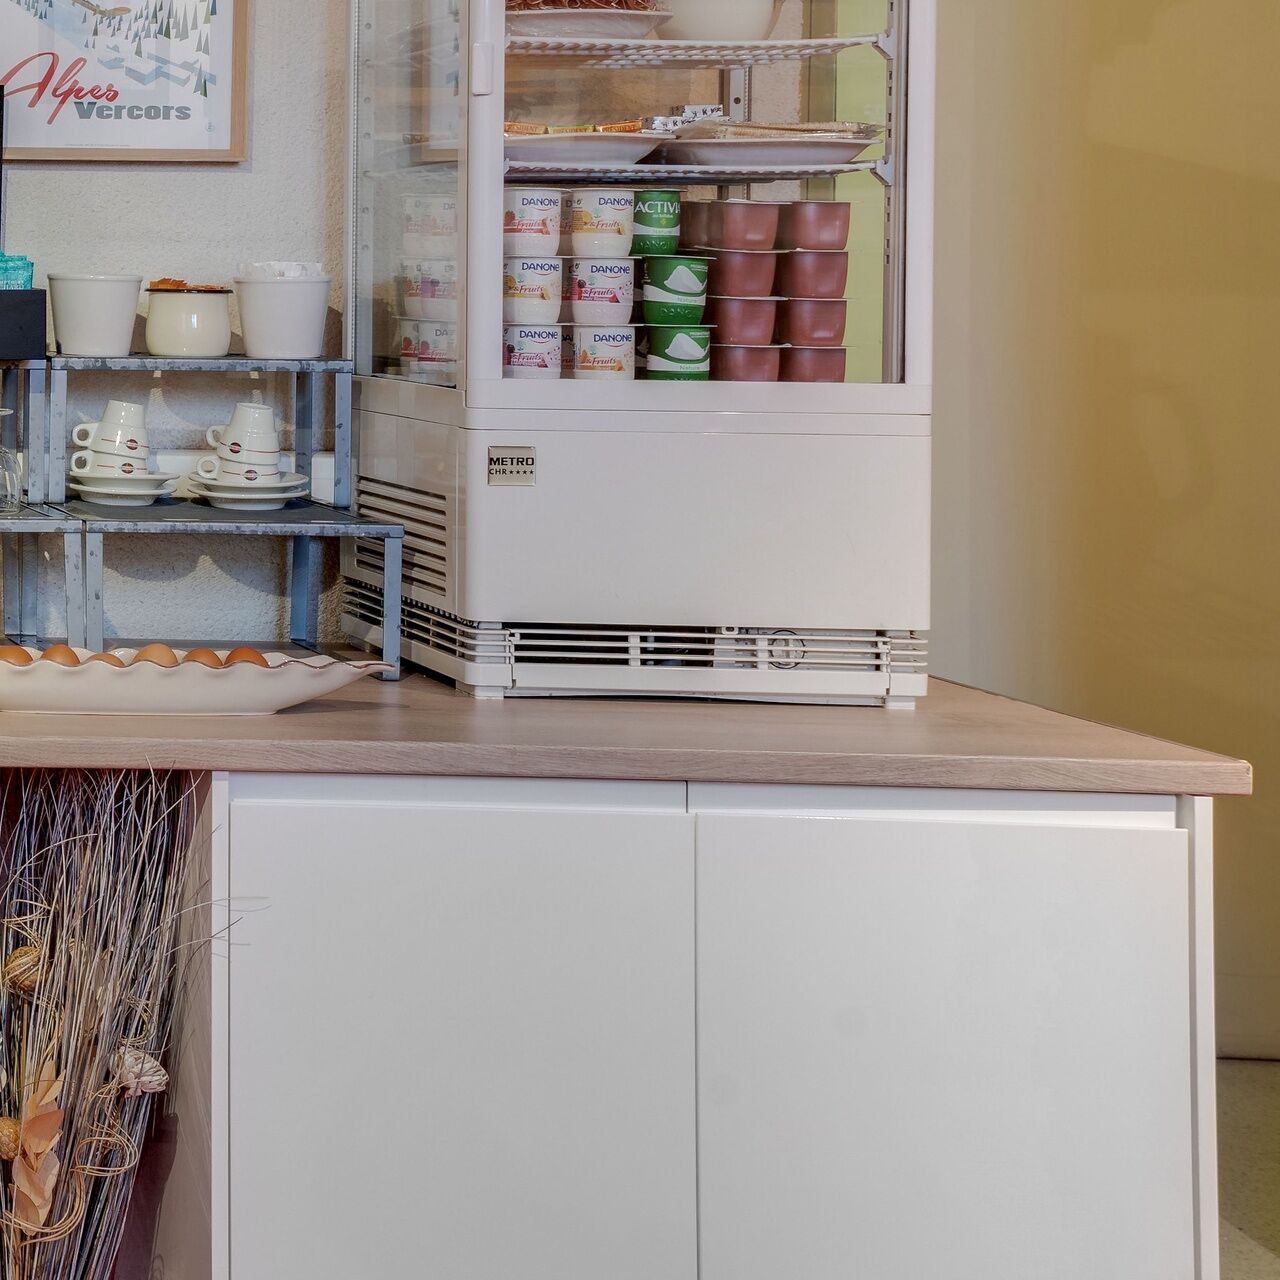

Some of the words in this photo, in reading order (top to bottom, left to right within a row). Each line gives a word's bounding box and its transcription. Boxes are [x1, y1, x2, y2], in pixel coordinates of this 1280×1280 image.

[74, 101, 191, 120] Vercors
[634, 201, 680, 213] ACTIVI
[489, 457, 535, 466] METRO
